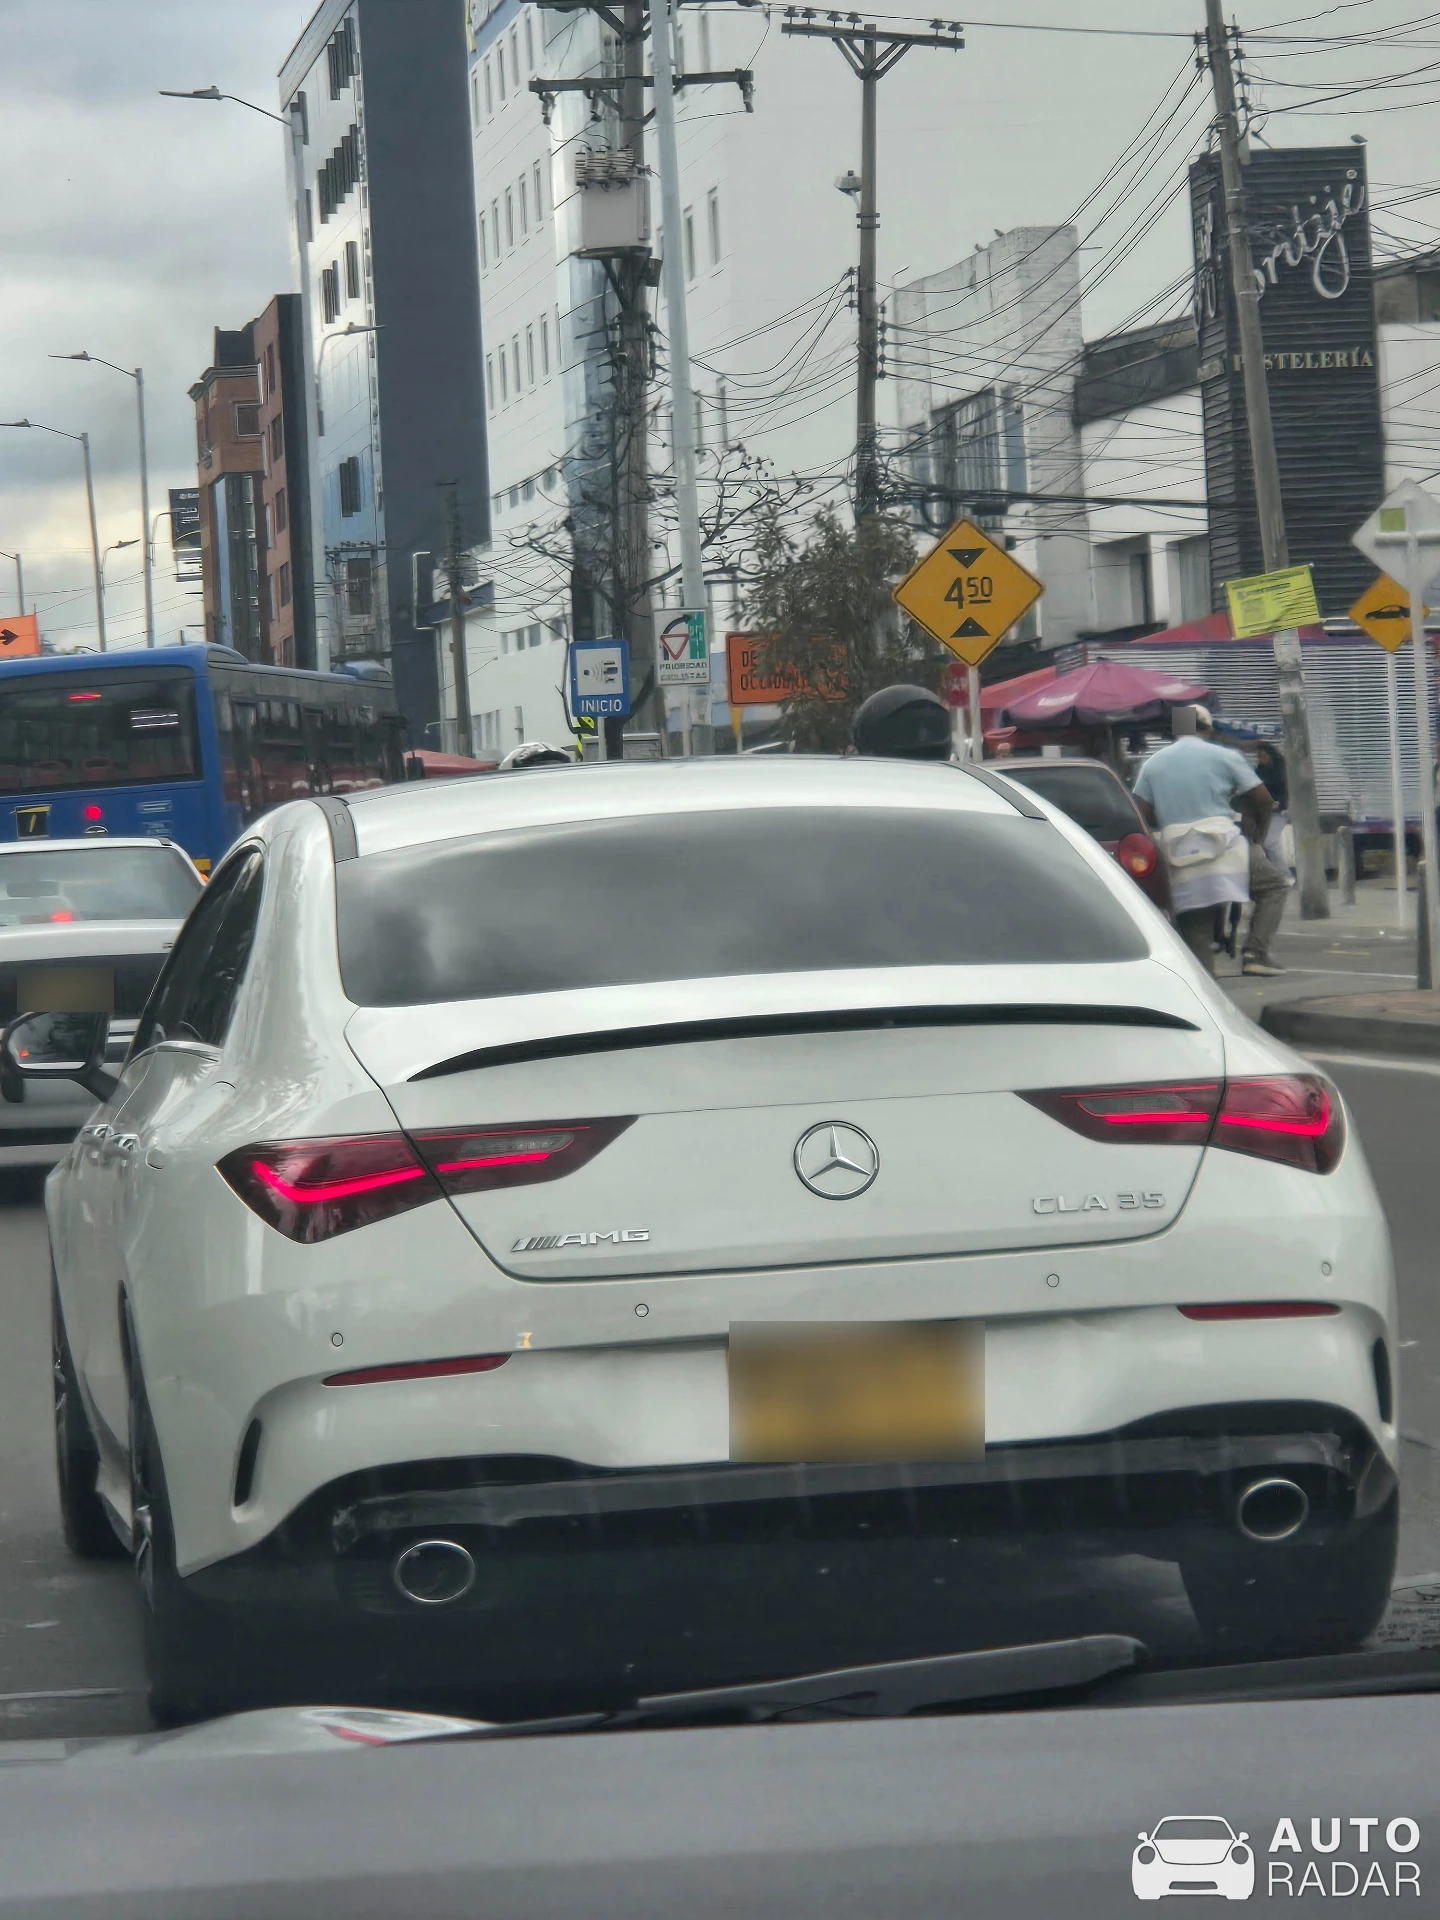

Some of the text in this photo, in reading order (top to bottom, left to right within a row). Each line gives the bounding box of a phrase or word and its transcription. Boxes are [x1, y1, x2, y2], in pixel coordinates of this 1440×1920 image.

[581, 699, 623, 712] INICIO
[1033, 1191, 1166, 1214] CLA 35
